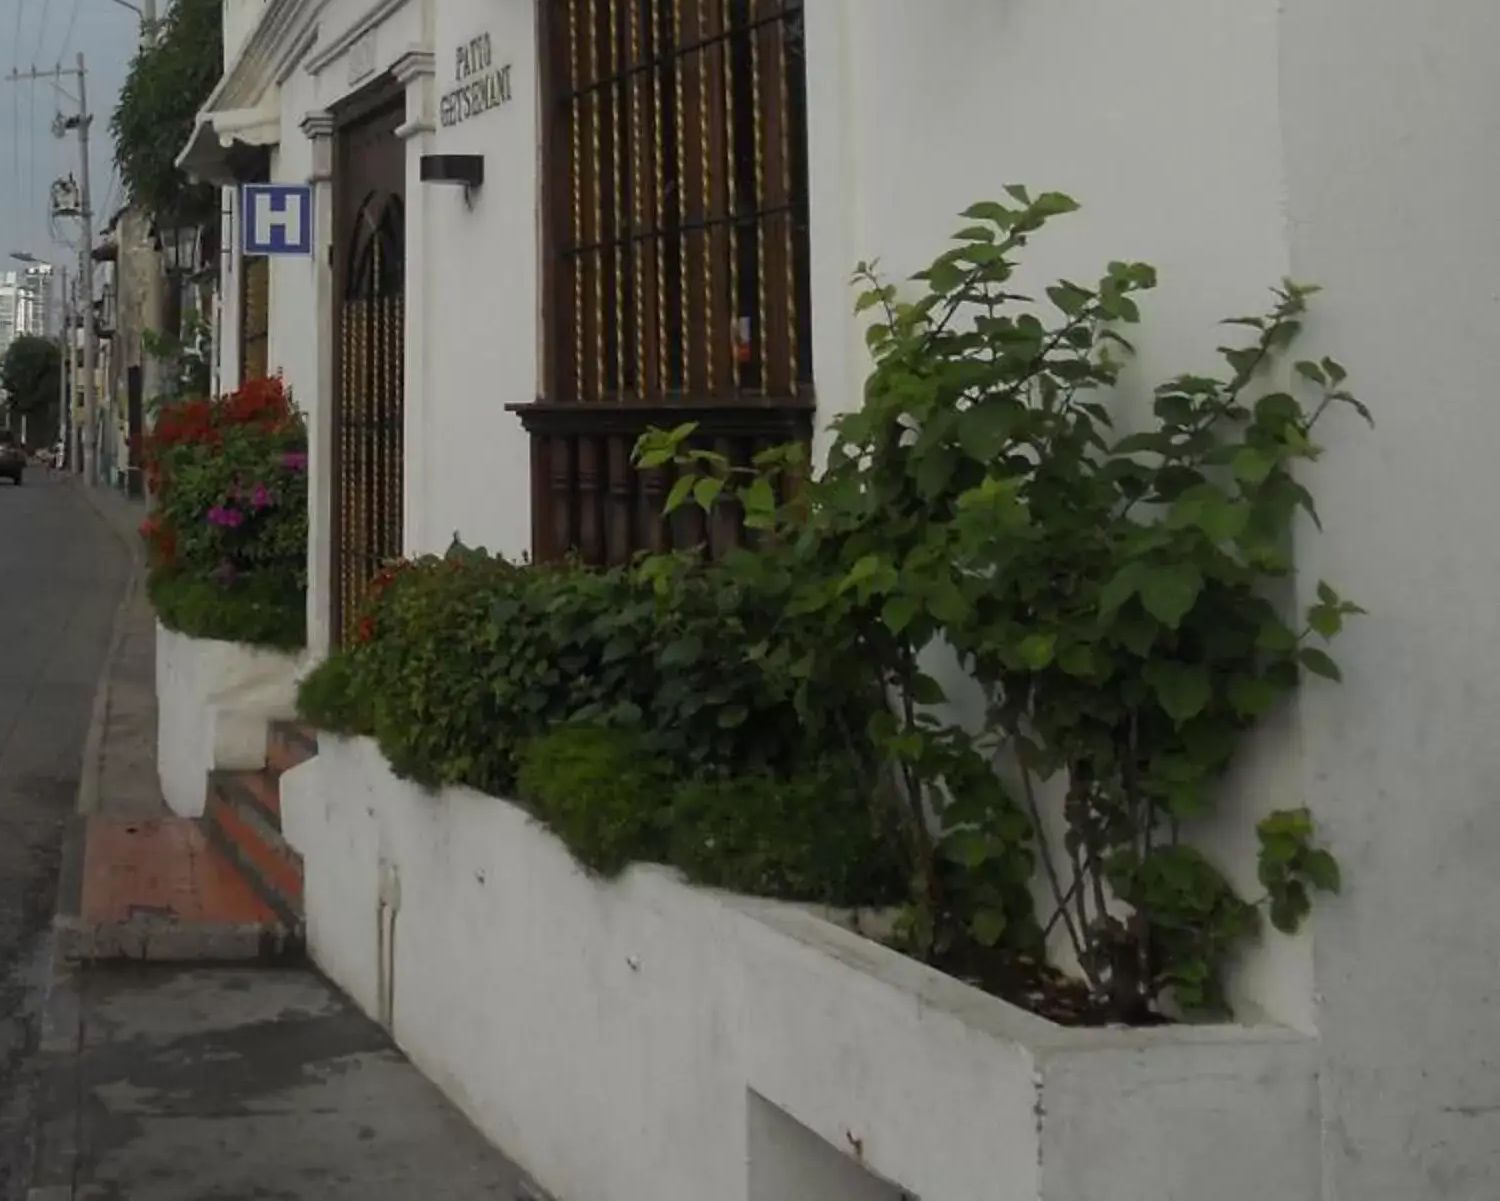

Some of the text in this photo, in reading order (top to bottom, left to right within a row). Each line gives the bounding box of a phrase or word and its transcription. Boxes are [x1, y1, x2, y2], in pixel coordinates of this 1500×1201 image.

[455, 31, 492, 81] PATIO
[439, 65, 512, 127] GETSEMANI
[255, 193, 301, 246] H
